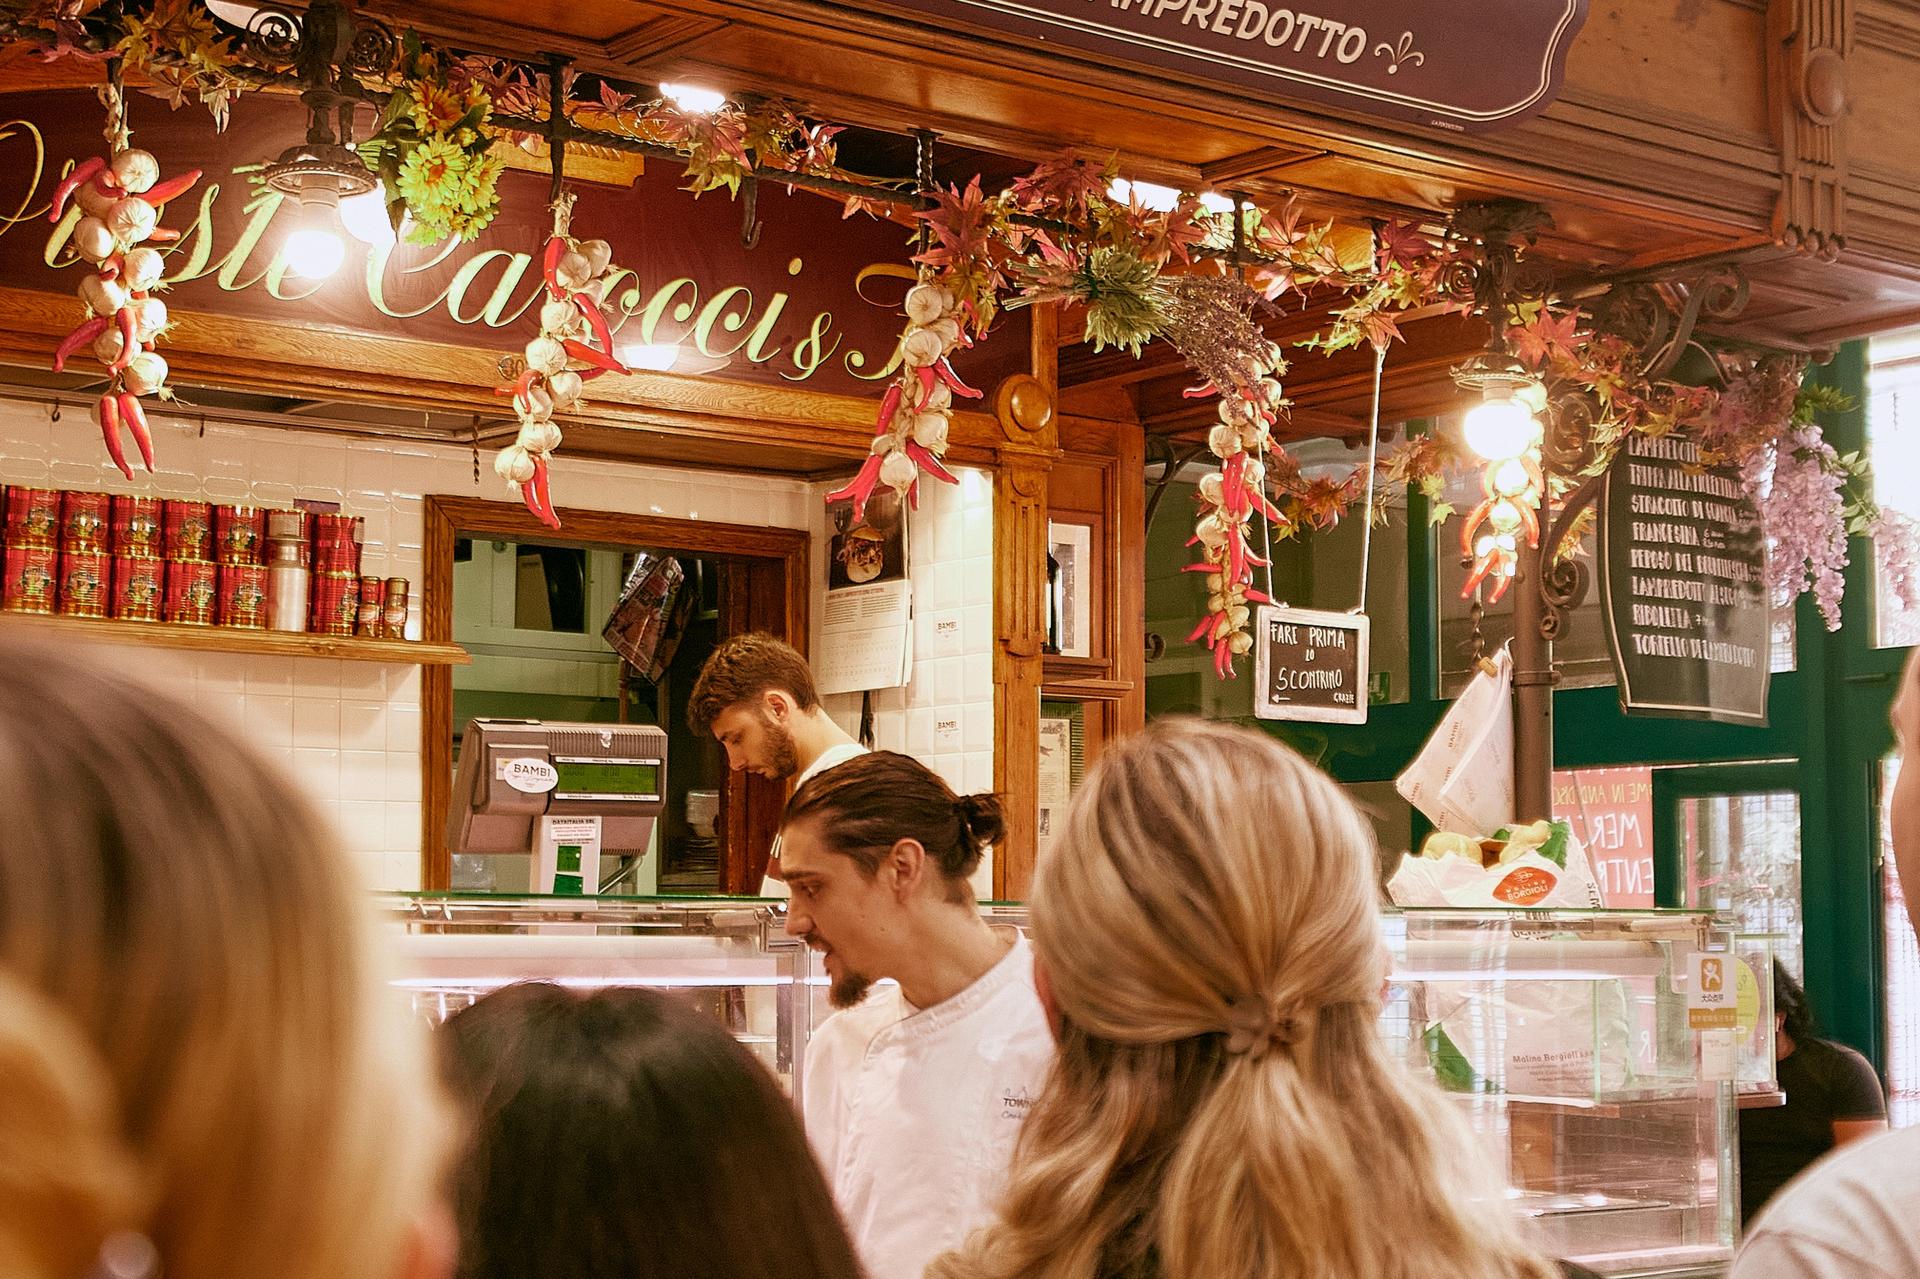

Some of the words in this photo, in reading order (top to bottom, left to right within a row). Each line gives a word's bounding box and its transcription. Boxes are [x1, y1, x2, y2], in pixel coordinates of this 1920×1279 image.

[780, 312, 843, 381] &
[1633, 522, 1700, 547] FRANCESINA
[1631, 548, 1673, 571] PEPOSO
[1675, 552, 1694, 573] DEL
[1632, 603, 1693, 630] RIBOLLITA
[1270, 624, 1299, 646] FARE
[1309, 627, 1346, 650] PRIMA
[1275, 667, 1343, 691] SCONTRINO
[513, 763, 551, 777] BAMBI
[1506, 885, 1549, 901] BORGIOLI
